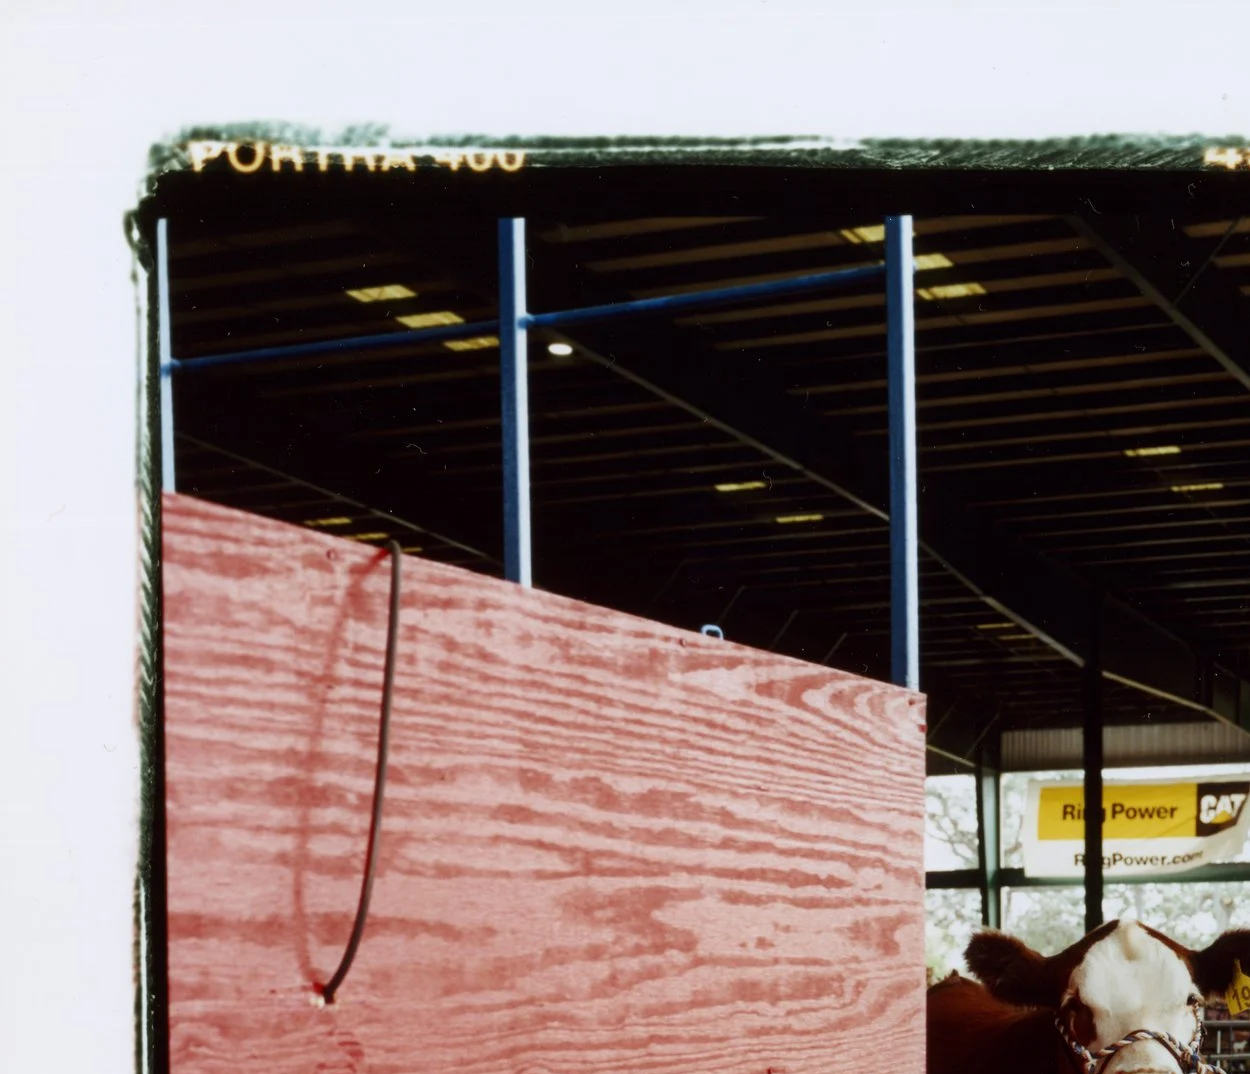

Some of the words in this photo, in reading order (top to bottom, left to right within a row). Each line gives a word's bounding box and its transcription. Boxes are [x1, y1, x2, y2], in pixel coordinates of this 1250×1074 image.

[1062, 804, 1106, 824] Ri
[1111, 803, 1178, 821] Power
[1199, 793, 1249, 825] CAT
[1074, 850, 1204, 869] RgPower.com
